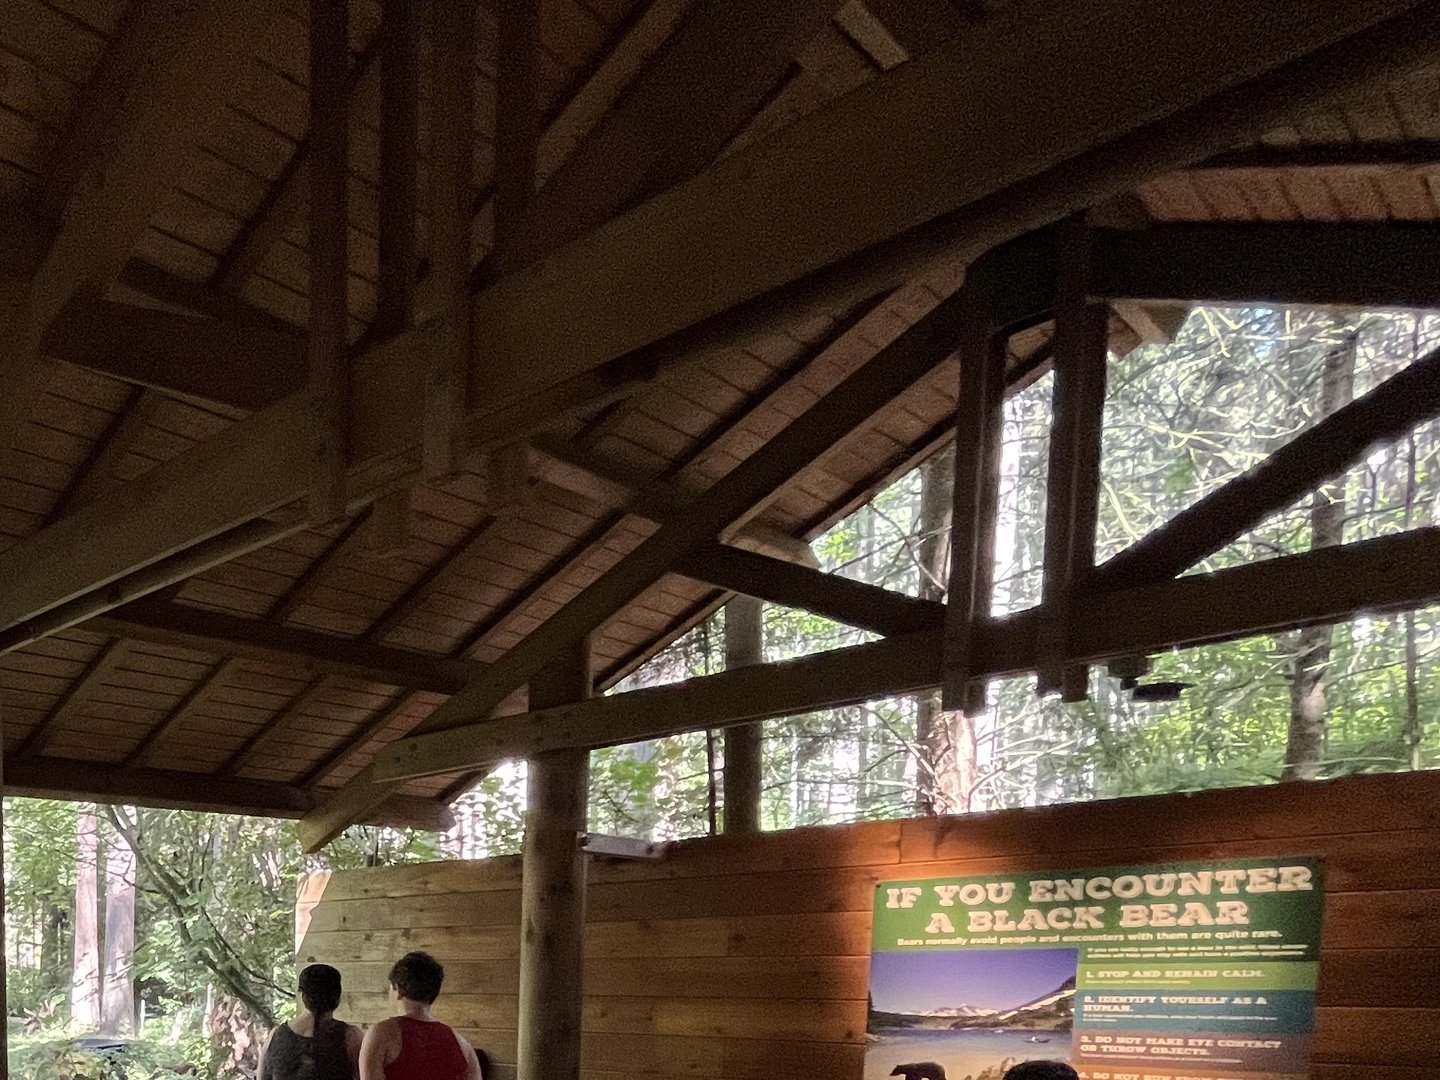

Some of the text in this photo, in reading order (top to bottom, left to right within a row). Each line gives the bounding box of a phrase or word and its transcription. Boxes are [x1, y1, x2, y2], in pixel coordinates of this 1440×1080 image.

[886, 866, 1313, 909] IF YOU ENCOUNTER
[925, 901, 1249, 933] A BLACK BEAR
[897, 930, 1283, 946] Bears normally avoid people and encounters with them are quite rare.
[1098, 970, 1130, 978] STOP
[1132, 970, 1161, 978] AND
[1164, 970, 1218, 978] REMAIN
[1098, 995, 1156, 1004] IDENTIFY
[1160, 996, 1228, 1005] YOURSELF
[1232, 997, 1253, 1005] AS
[1255, 997, 1268, 1005] A
[1080, 1035, 1282, 1049] 3. DO NOT MAKE EYE CONTACT
[1080, 1044, 1211, 1056] OR THROW OBJECTS.
[1093, 1072, 1110, 1080] DO
